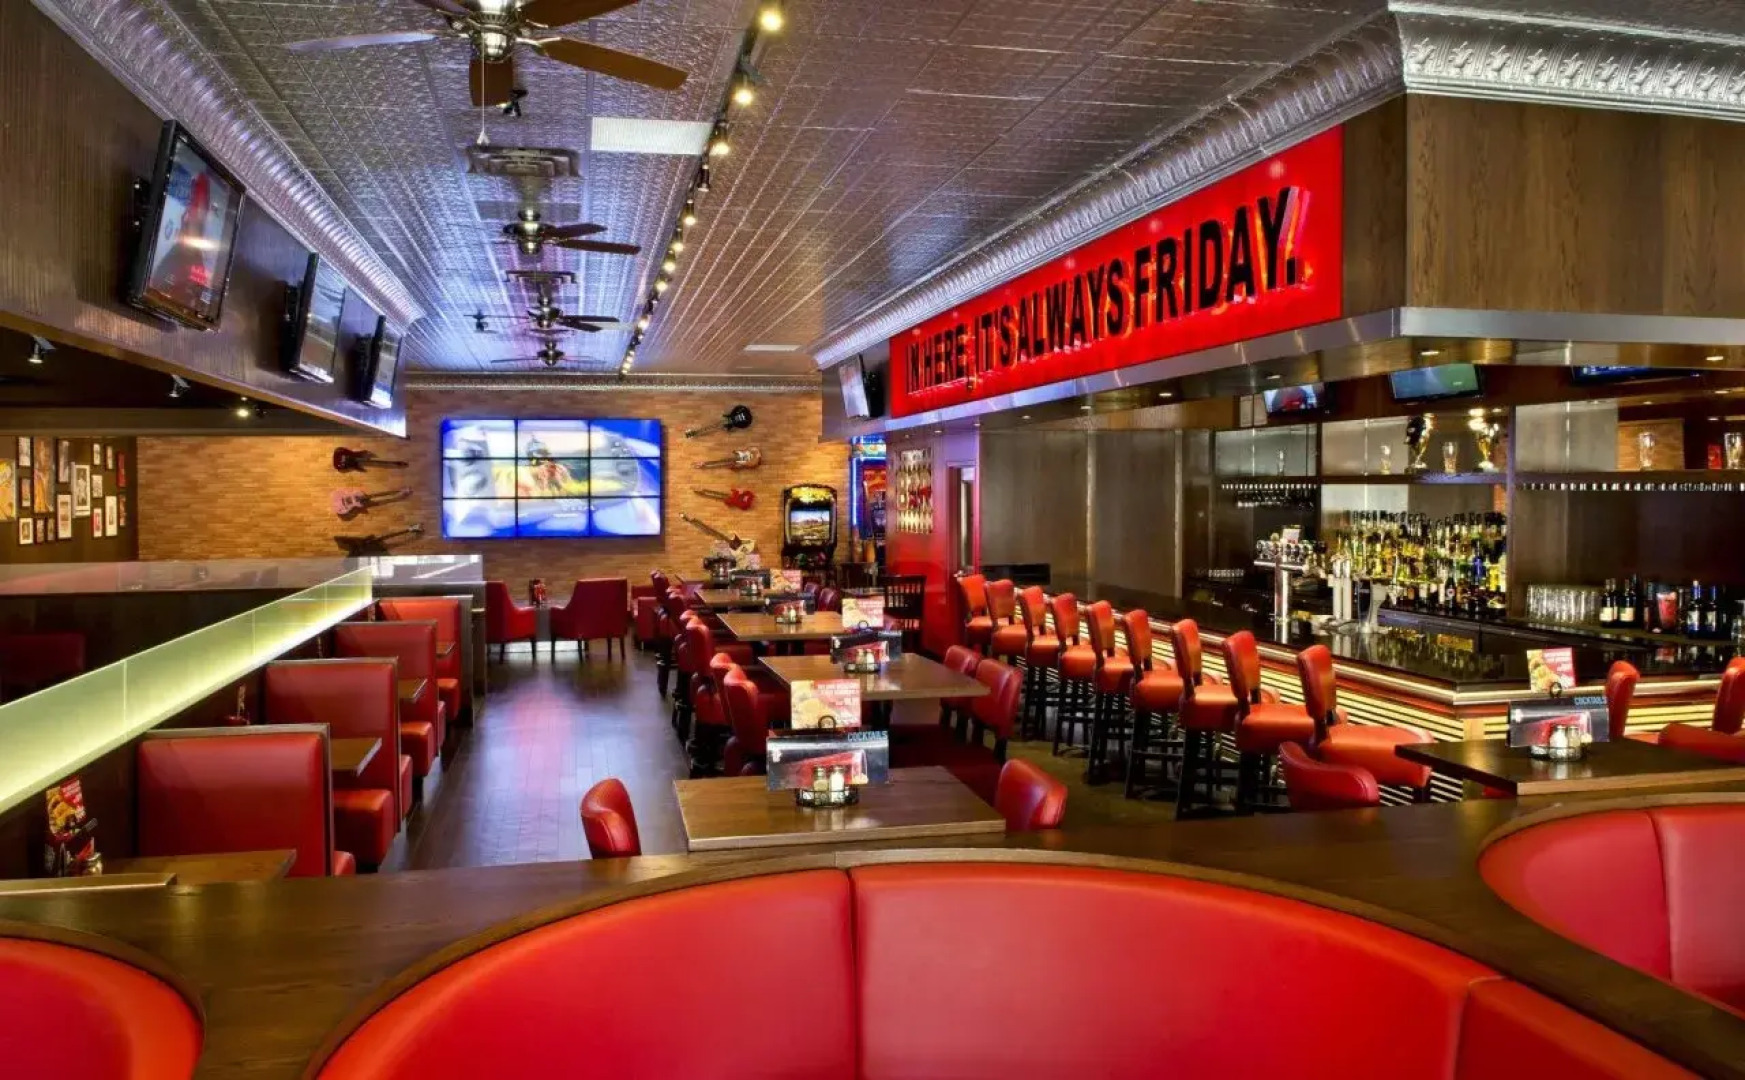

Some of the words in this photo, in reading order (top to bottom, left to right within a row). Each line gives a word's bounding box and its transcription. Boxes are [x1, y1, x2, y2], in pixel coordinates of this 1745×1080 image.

[905, 343, 920, 394] IN
[924, 323, 974, 391] HERE,
[975, 304, 1014, 374] IT'S
[1016, 259, 1123, 362] ALWAYS
[1134, 186, 1299, 328] FRIDAY.
[847, 730, 888, 742] COCKTAILS
